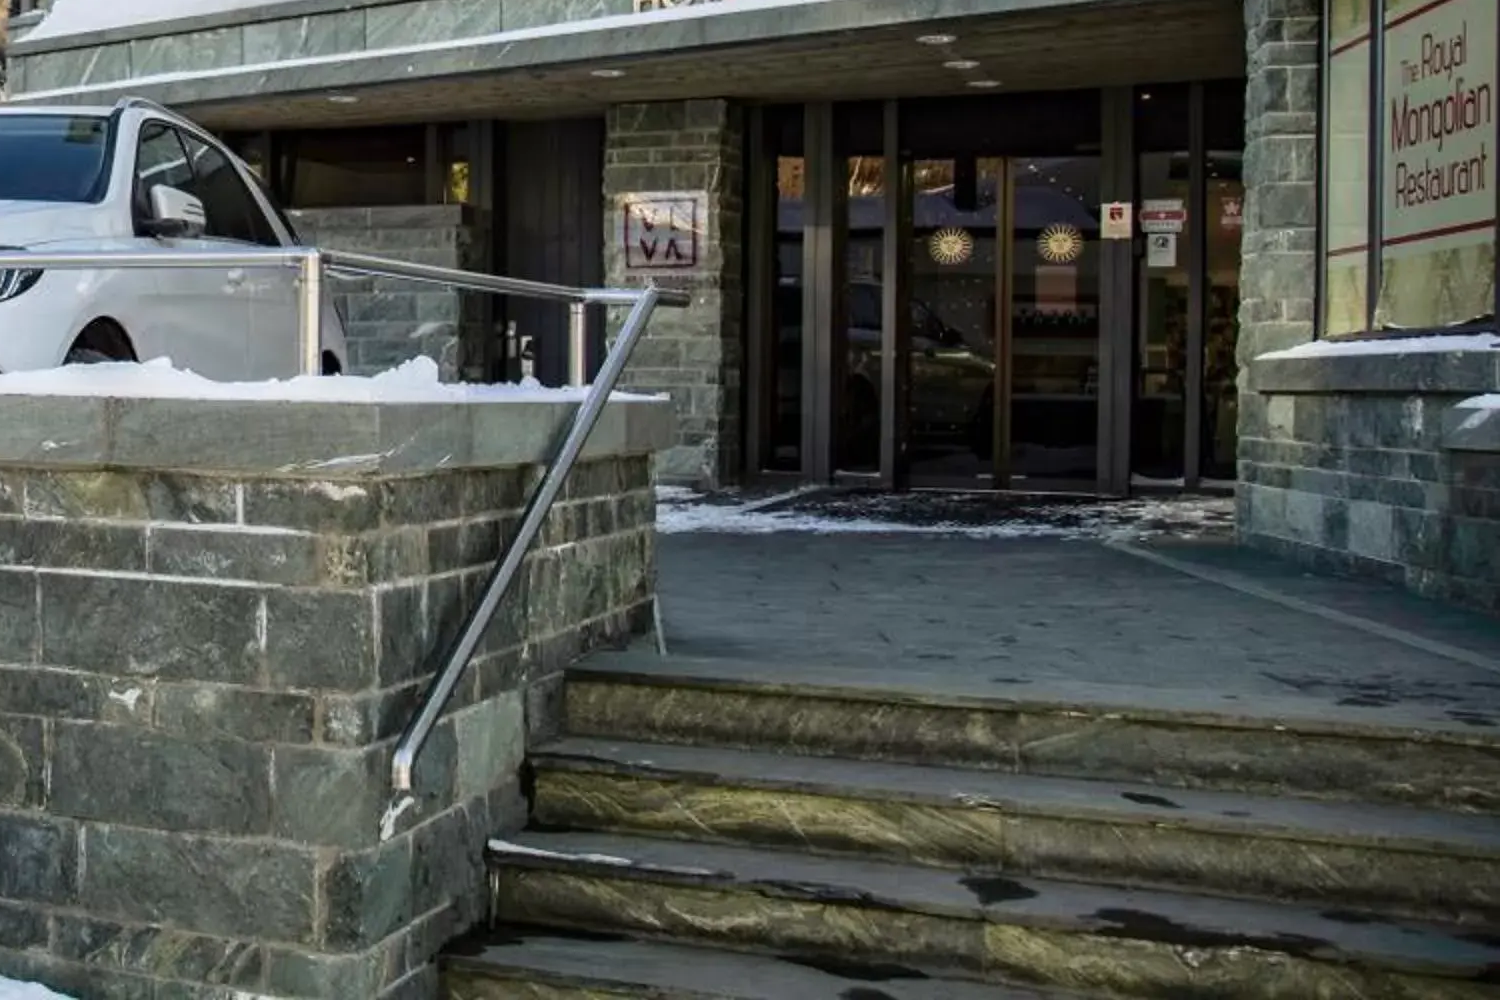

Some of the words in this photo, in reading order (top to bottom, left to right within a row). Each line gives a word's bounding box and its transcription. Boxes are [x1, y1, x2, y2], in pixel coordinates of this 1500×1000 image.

[1421, 20, 1467, 81] Royal
[1391, 77, 1491, 152] Mongolian
[1395, 141, 1487, 209] Restaurant
